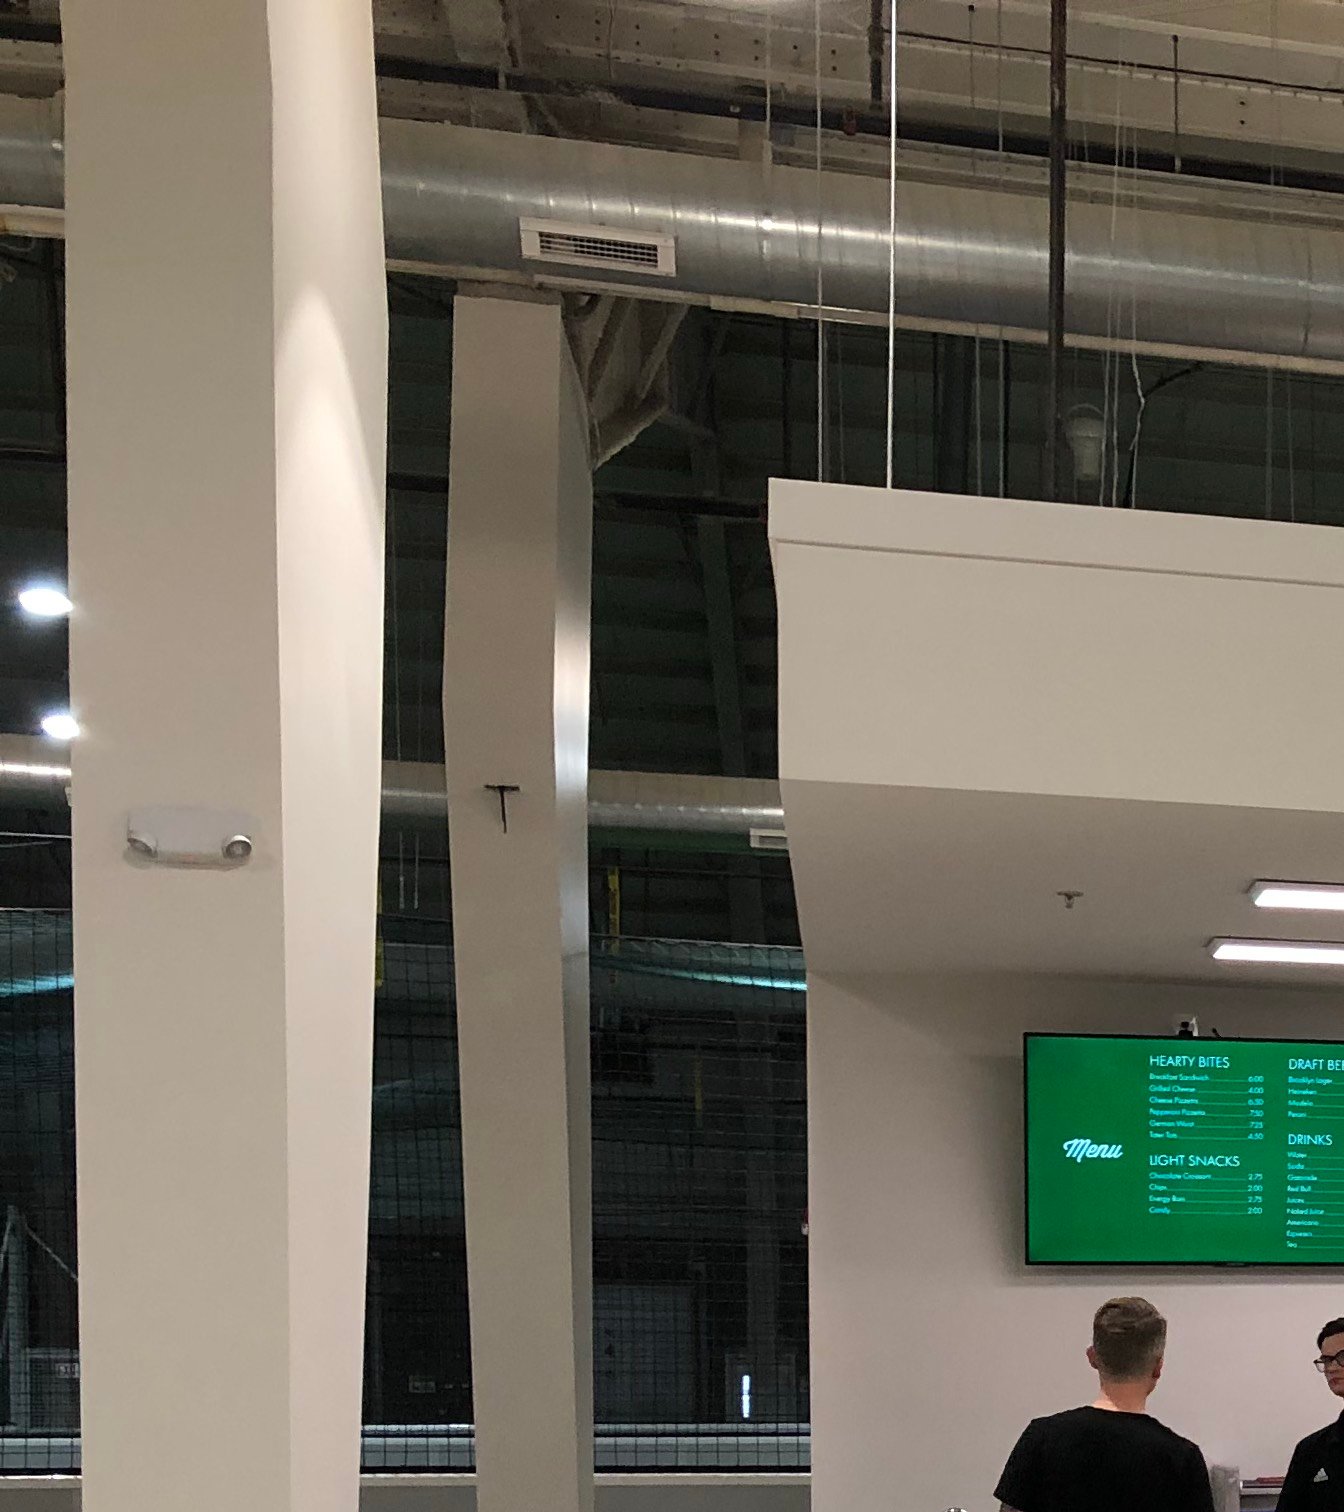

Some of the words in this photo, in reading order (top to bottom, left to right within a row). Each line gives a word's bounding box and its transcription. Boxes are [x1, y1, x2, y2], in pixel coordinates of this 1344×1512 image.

[1149, 1055, 1195, 1067] HEARTY
[1199, 1056, 1230, 1068] BITES
[1289, 1059, 1324, 1070] DRAFT
[1288, 1134, 1332, 1145] DRINKS
[1062, 1138, 1123, 1162] Menu
[1149, 1155, 1185, 1166] LIGHT
[1188, 1155, 1240, 1167] SNACKS
[1149, 1195, 1170, 1203] Energy
